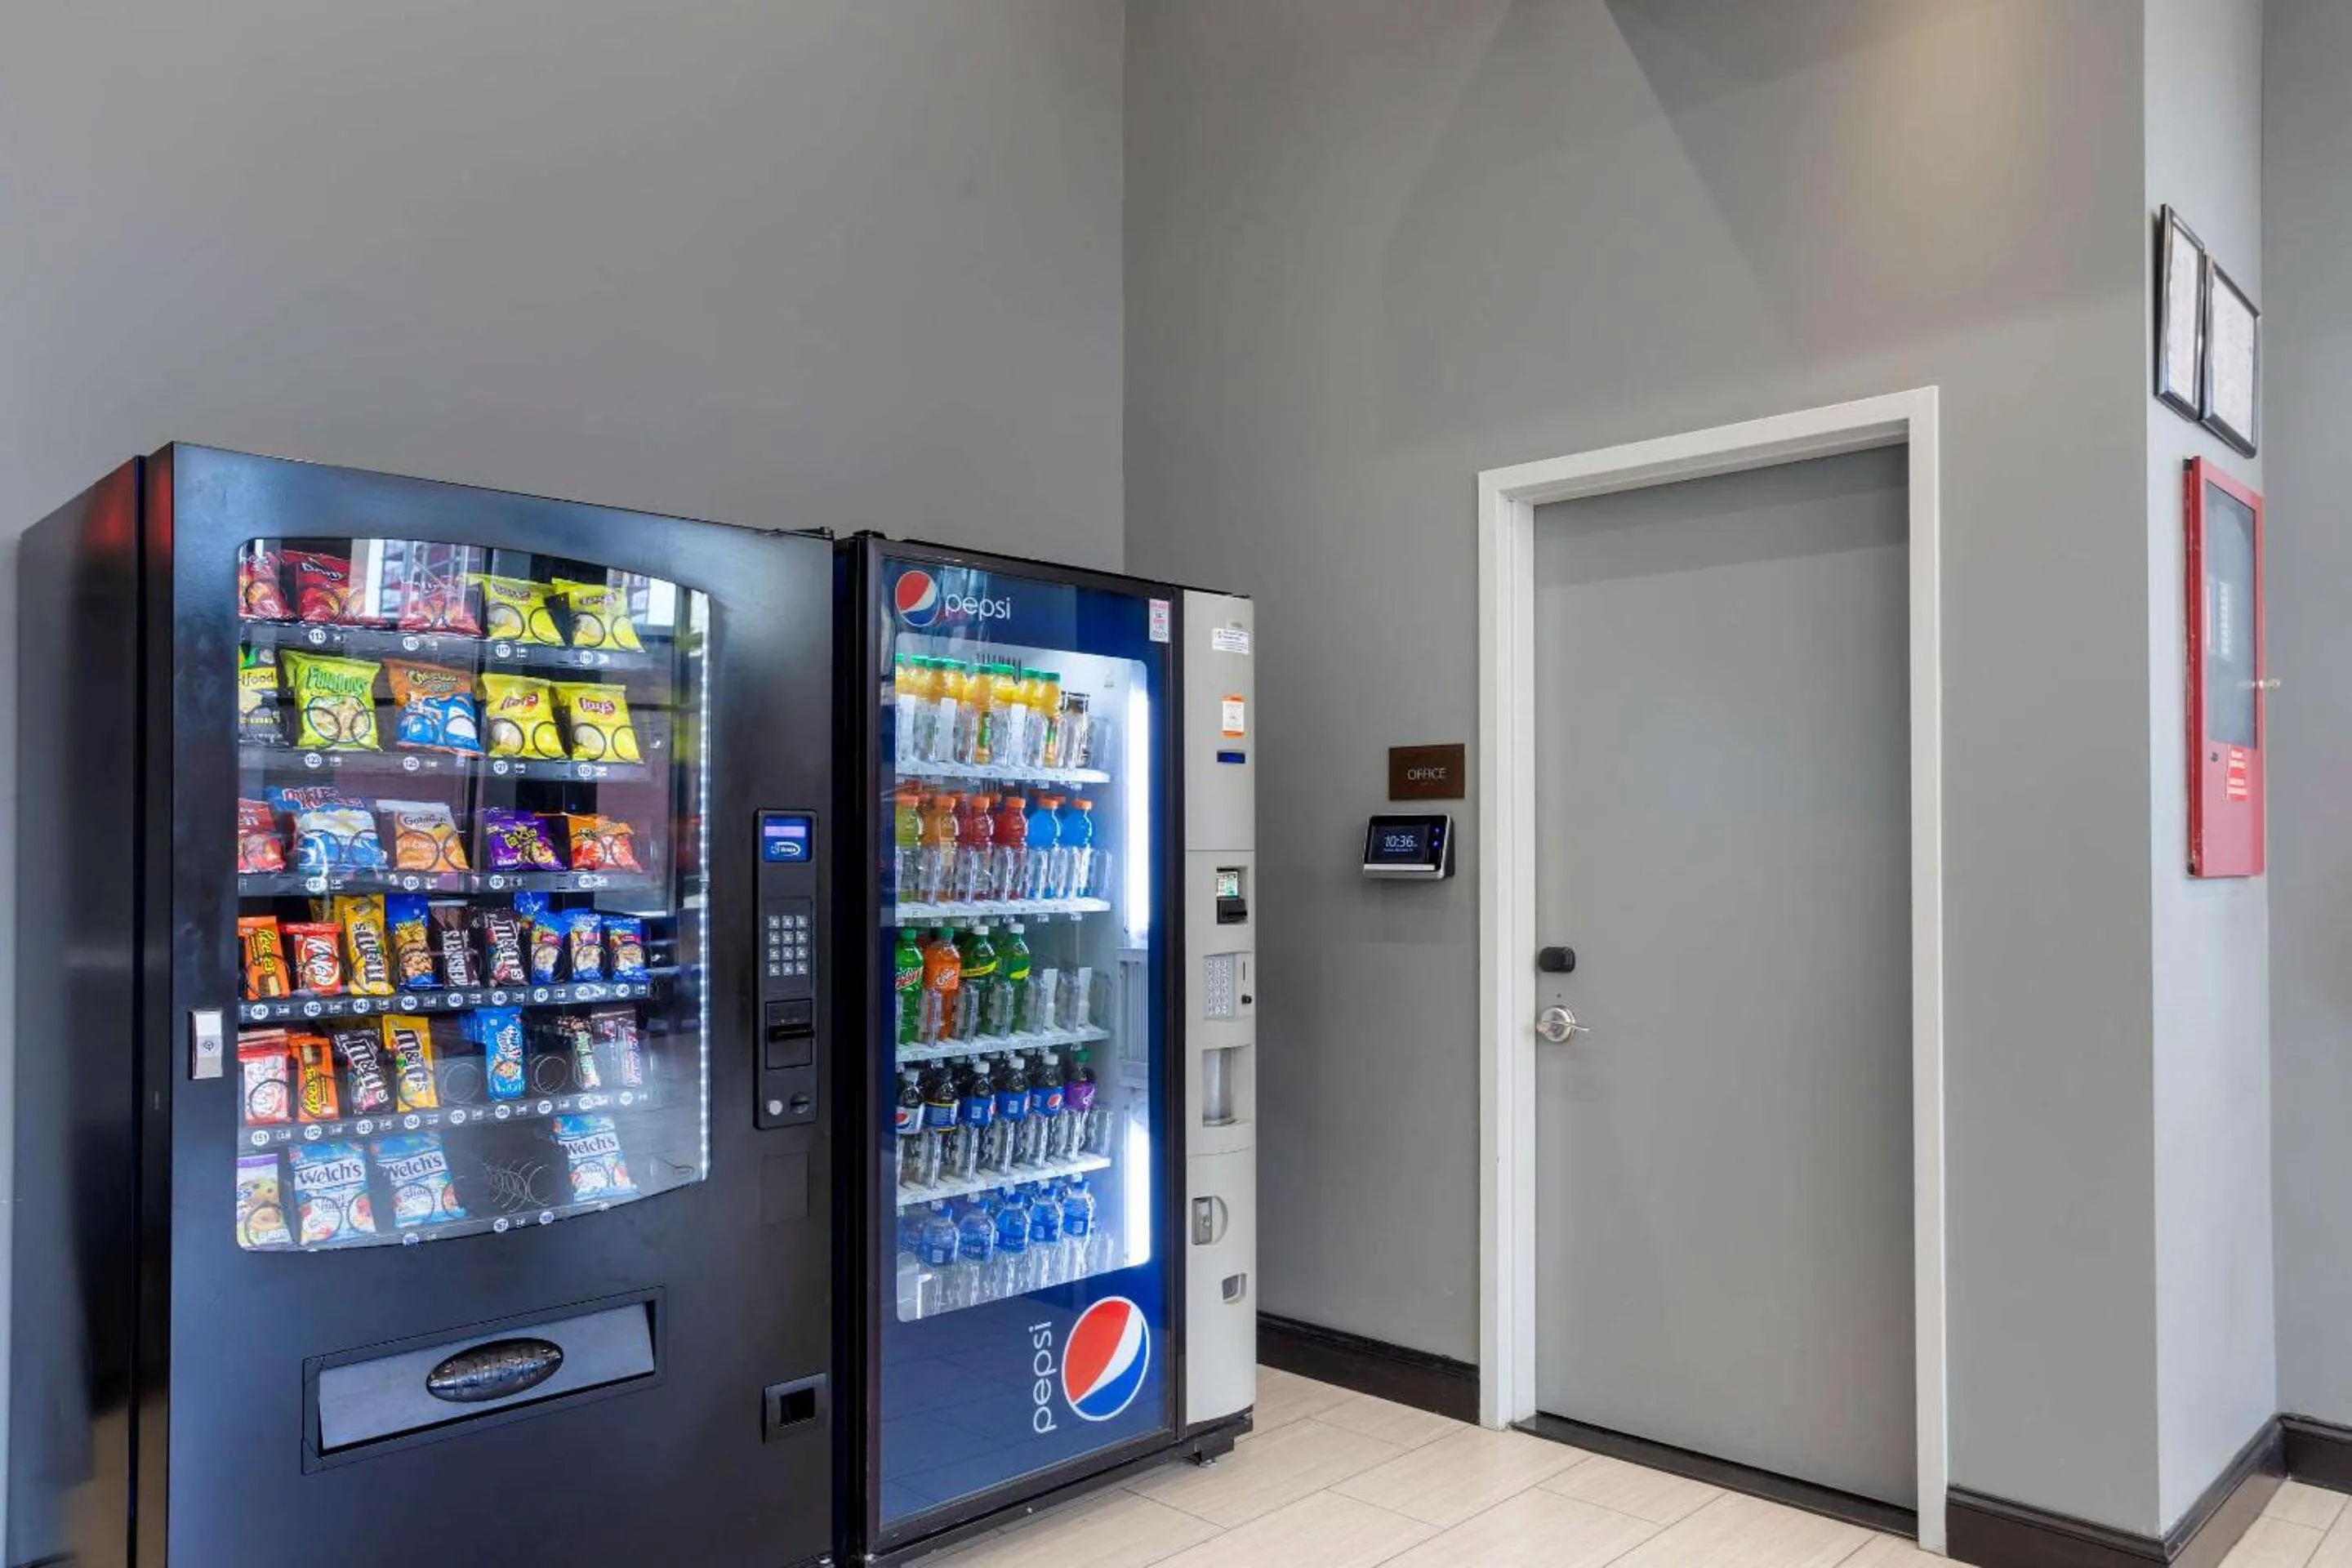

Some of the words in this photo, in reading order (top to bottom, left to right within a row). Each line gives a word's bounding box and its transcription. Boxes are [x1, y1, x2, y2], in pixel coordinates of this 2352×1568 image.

[944, 593, 1011, 621] pepsi
[1406, 767, 1447, 781] OFFICE
[1384, 835, 1414, 848] 10:36
[296, 1162, 362, 1185] Welch's
[1028, 1320, 1058, 1435] pepsi
